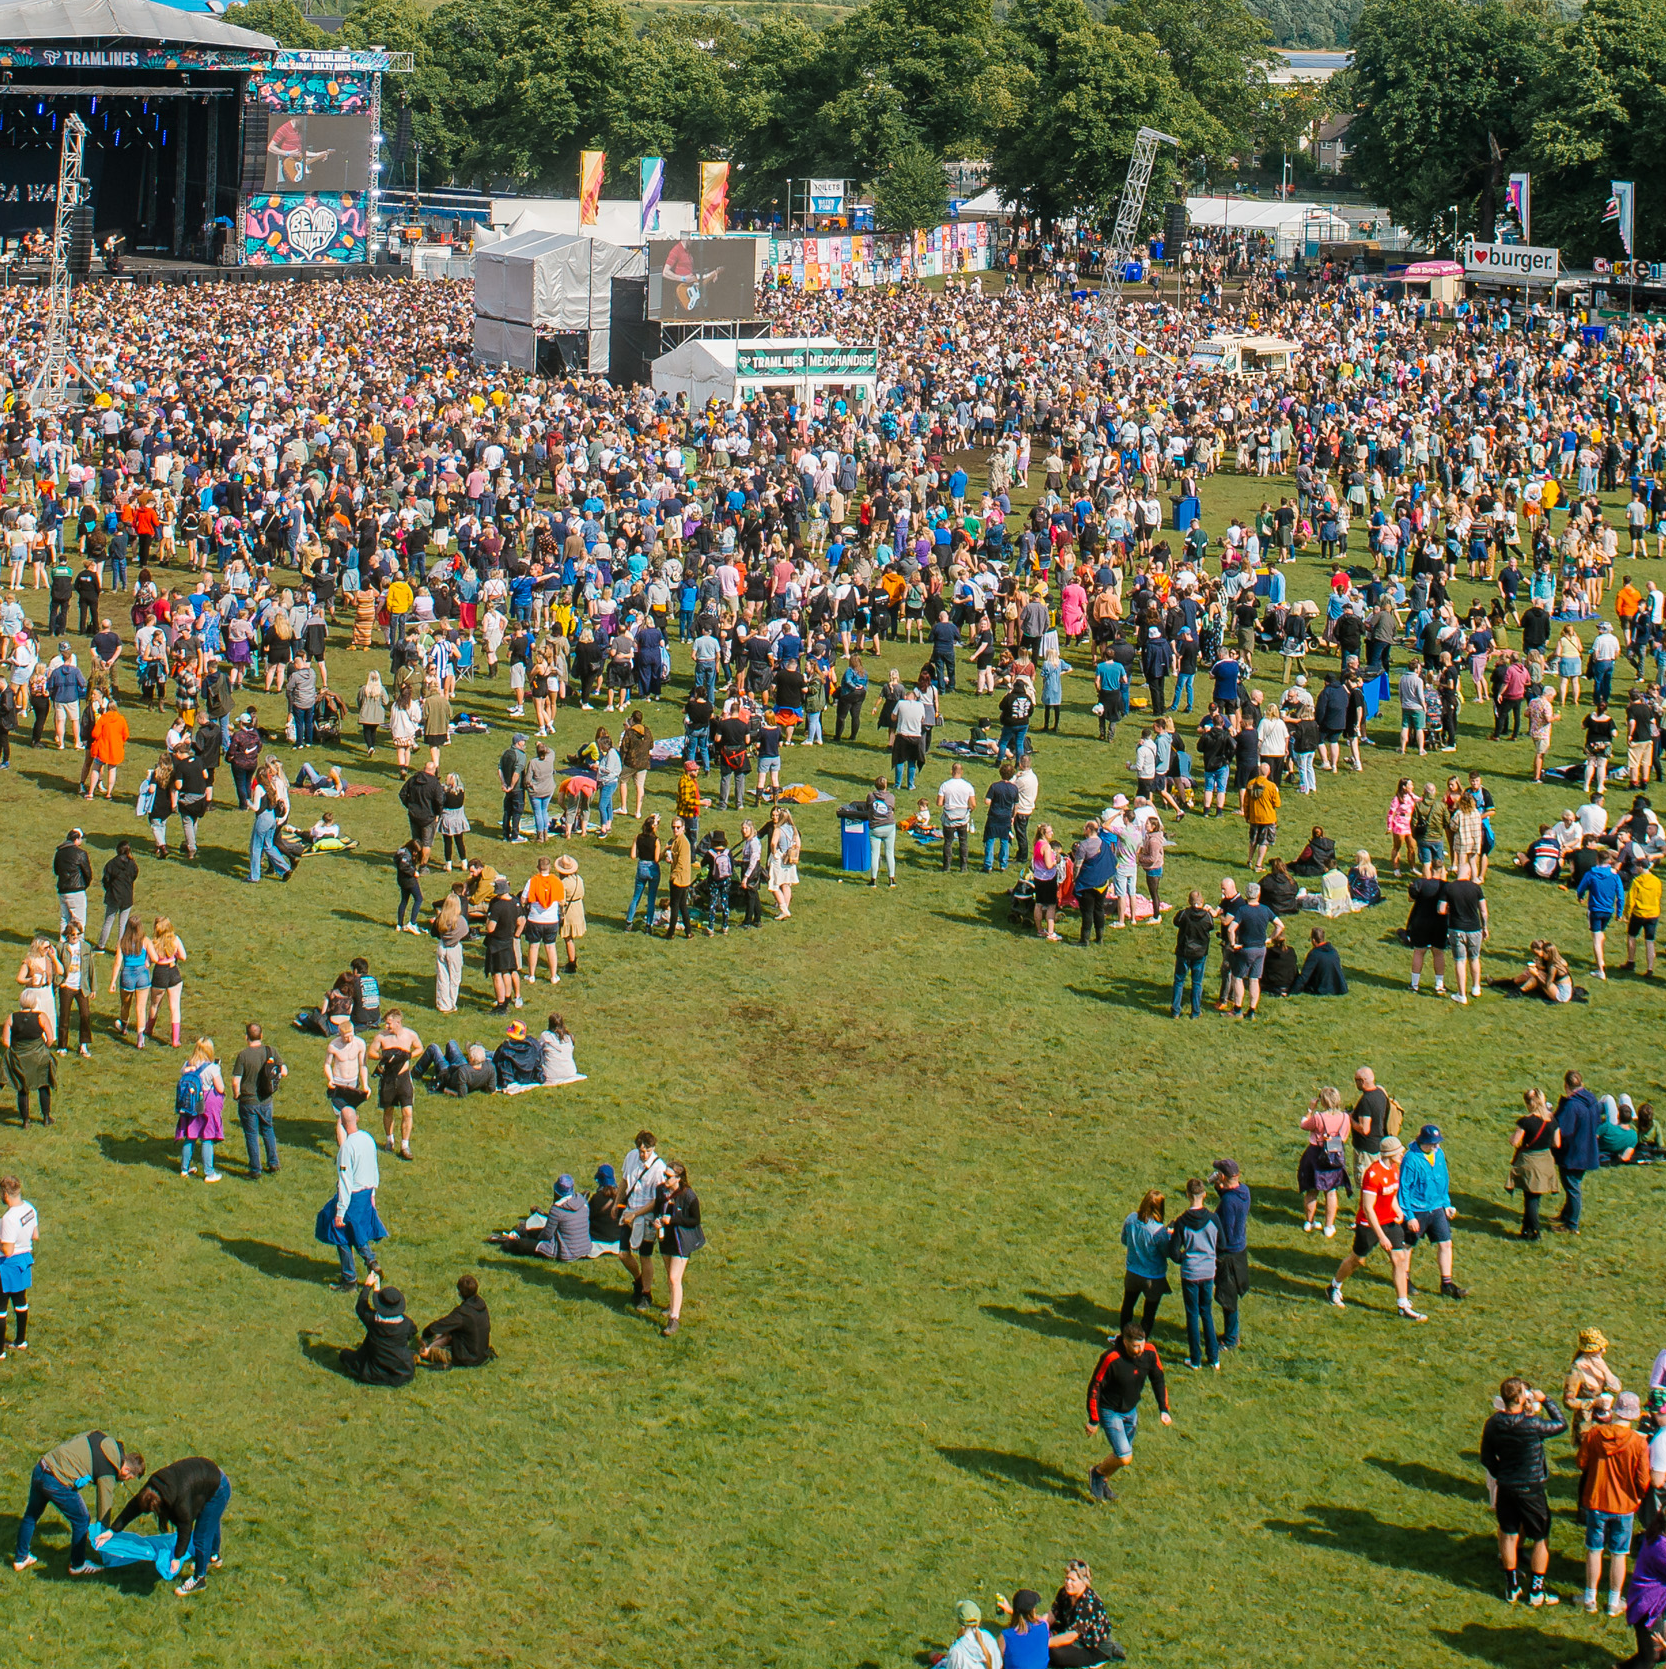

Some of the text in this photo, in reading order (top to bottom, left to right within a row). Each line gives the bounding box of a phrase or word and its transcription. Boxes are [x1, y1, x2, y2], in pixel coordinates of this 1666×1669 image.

[64, 50, 139, 66] TRAMLINES
[310, 53, 351, 62] TRAMLINES
[276, 62, 290, 70] THE
[814, 184, 840, 192] TOILETS
[291, 210, 334, 232] BE MORE
[291, 232, 332, 251] NULTY
[1468, 245, 1552, 273] i burger.
[753, 354, 874, 368] TRAMLINES MERCHANDISE
